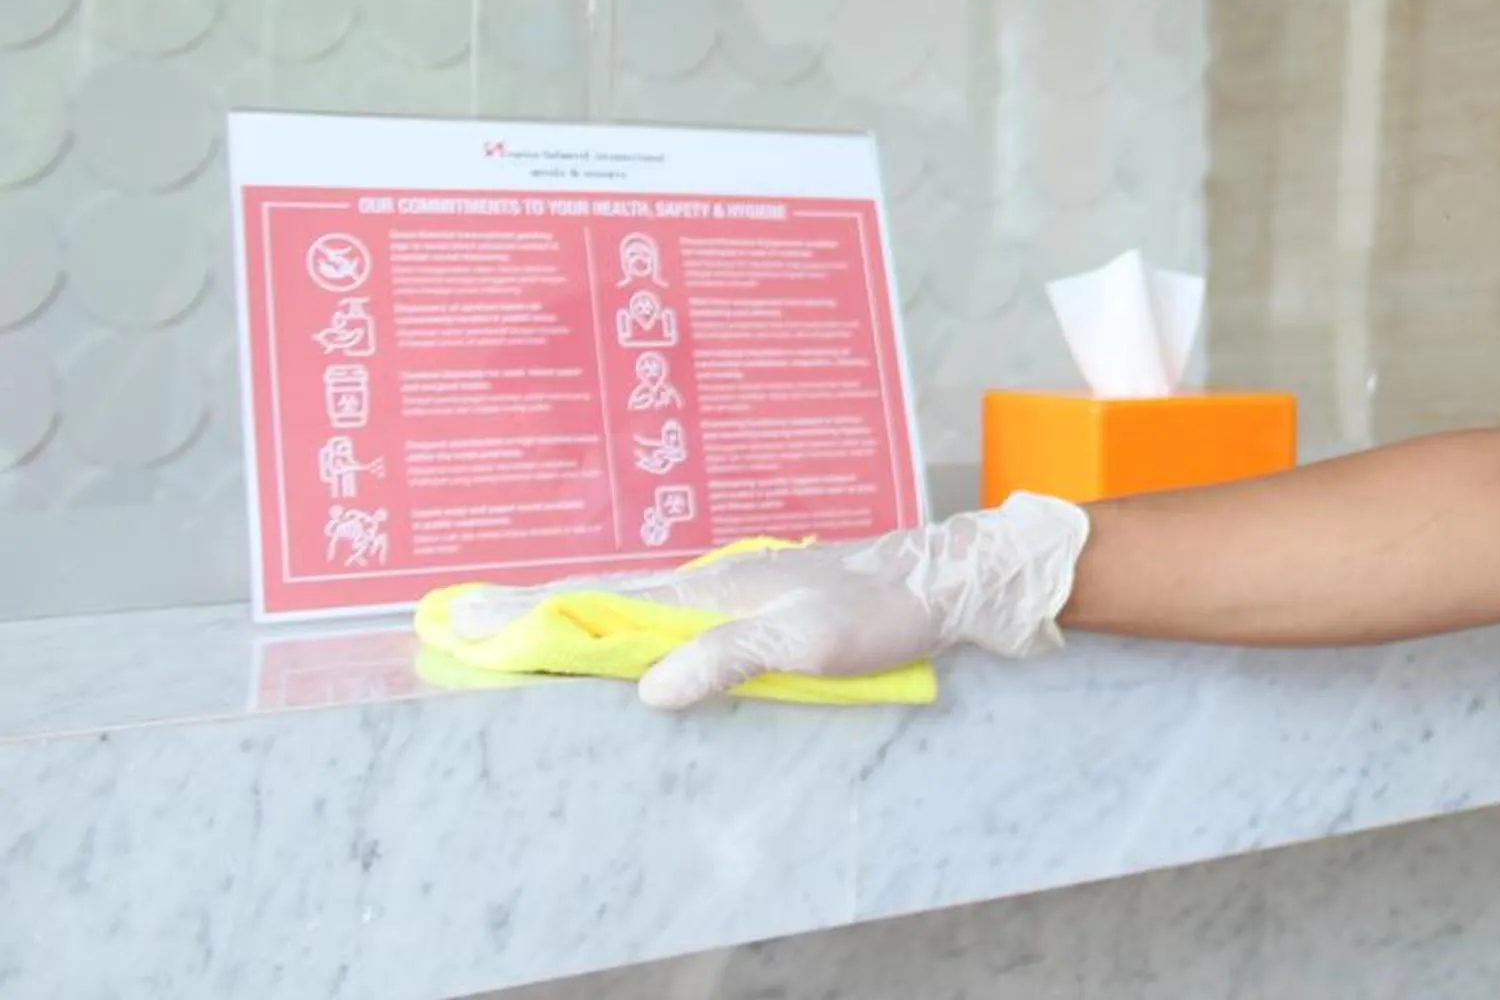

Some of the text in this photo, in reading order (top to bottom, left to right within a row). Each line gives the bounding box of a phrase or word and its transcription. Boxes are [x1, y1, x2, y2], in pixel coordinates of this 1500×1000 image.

[358, 197, 394, 215] OUR
[398, 197, 519, 216] COMMITMENTS
[523, 199, 544, 216] TO
[549, 199, 588, 217] YOUR
[656, 201, 710, 218] SAFETY
[712, 202, 726, 219] &
